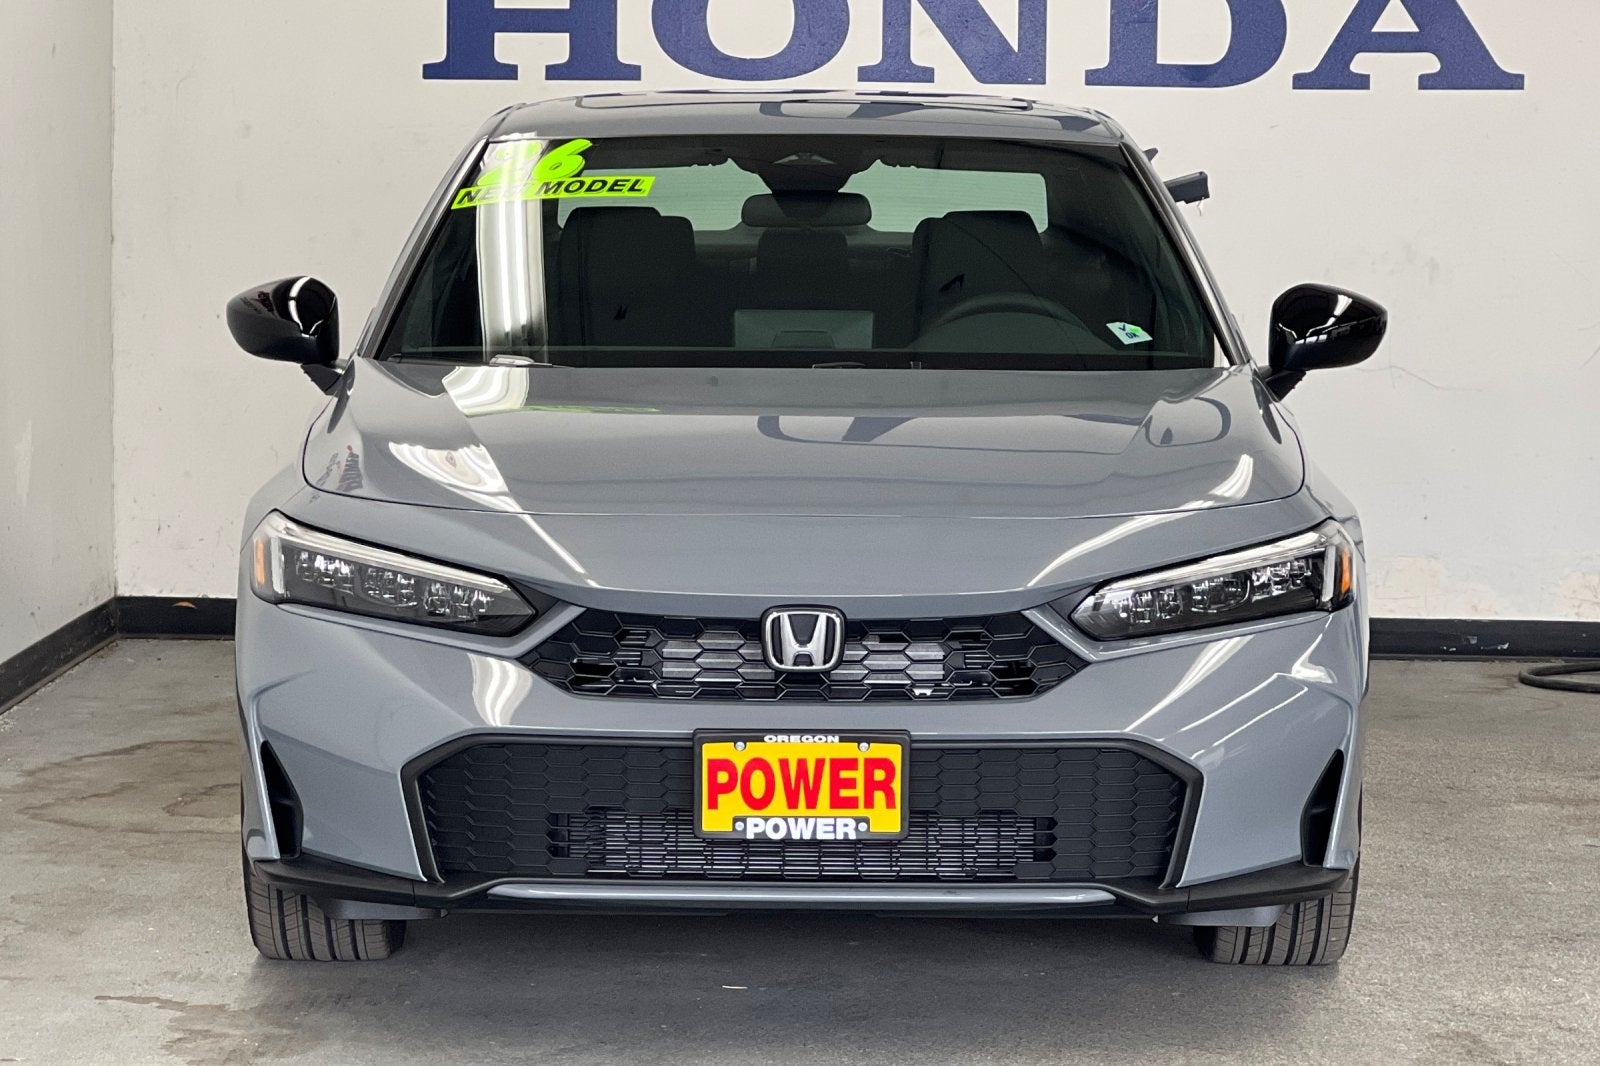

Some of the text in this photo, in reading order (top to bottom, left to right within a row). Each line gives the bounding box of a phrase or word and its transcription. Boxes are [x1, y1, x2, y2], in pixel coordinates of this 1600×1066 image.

[423, 0, 1525, 89] HONDA
[456, 178, 644, 204] NE MODEL
[763, 734, 840, 743] OREGON
[707, 757, 896, 810] POWER
[746, 817, 857, 840] POWER
